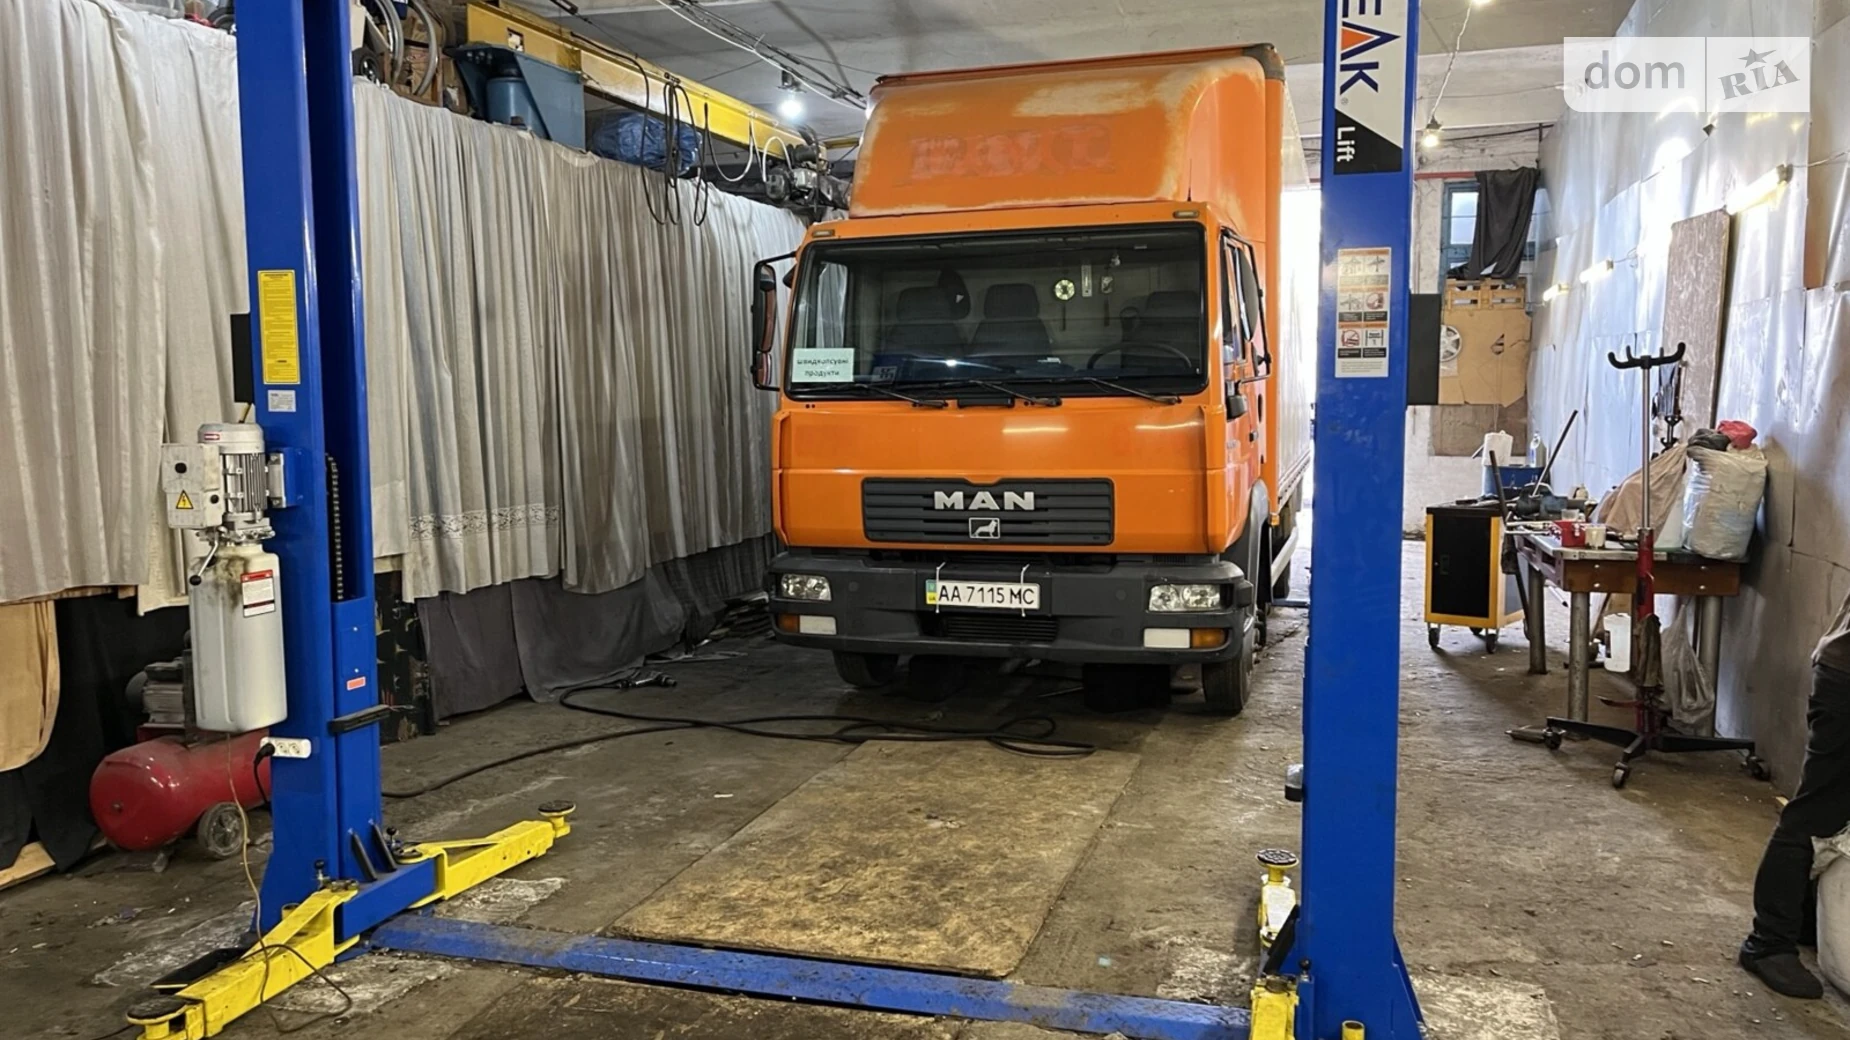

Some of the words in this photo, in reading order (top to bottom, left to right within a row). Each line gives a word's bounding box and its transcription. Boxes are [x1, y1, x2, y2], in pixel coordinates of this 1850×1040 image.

[1337, 126, 1356, 162] Lift
[934, 491, 1035, 511] MAN
[939, 585, 962, 602] AA
[967, 586, 1005, 604] 7115
[1010, 588, 1035, 605] MC
